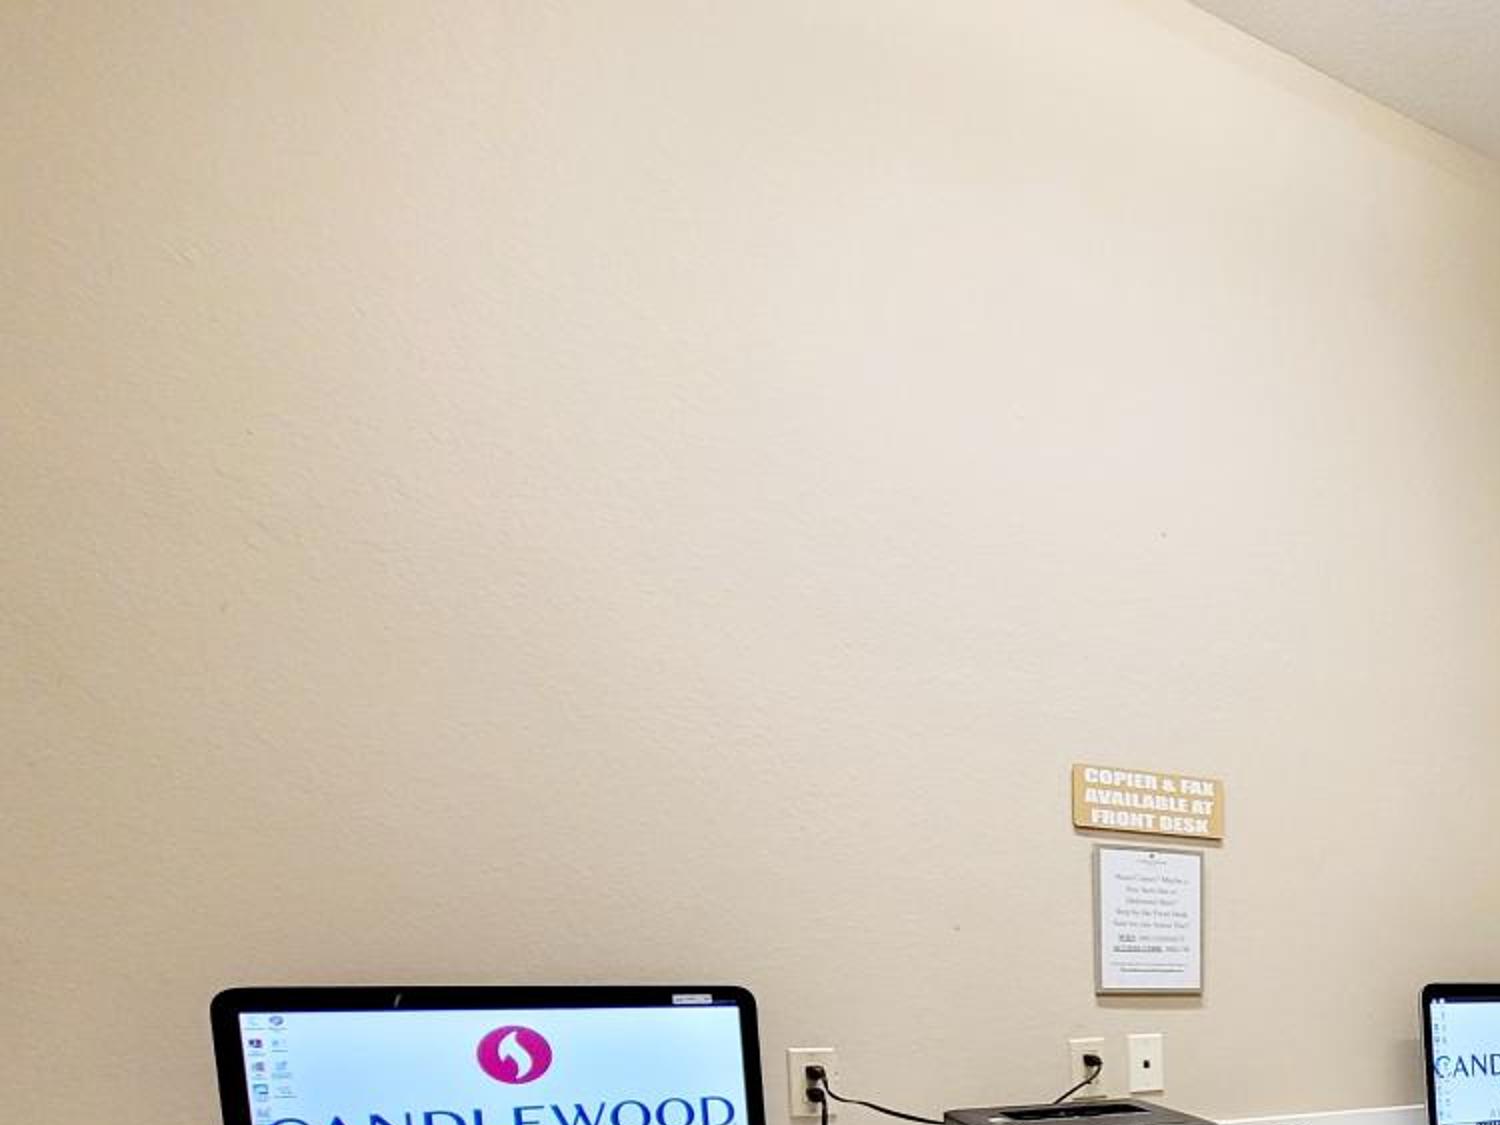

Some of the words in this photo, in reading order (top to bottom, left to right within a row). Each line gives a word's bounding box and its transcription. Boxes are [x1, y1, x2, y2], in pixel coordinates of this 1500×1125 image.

[1084, 768, 1157, 791] COPIER
[1161, 776, 1176, 793] &
[1180, 778, 1215, 796] FAX
[1084, 788, 1189, 813] AVAILABLE
[1190, 799, 1215, 815] AT
[1091, 808, 1156, 828] FRONT
[1159, 814, 1209, 834] DESK
